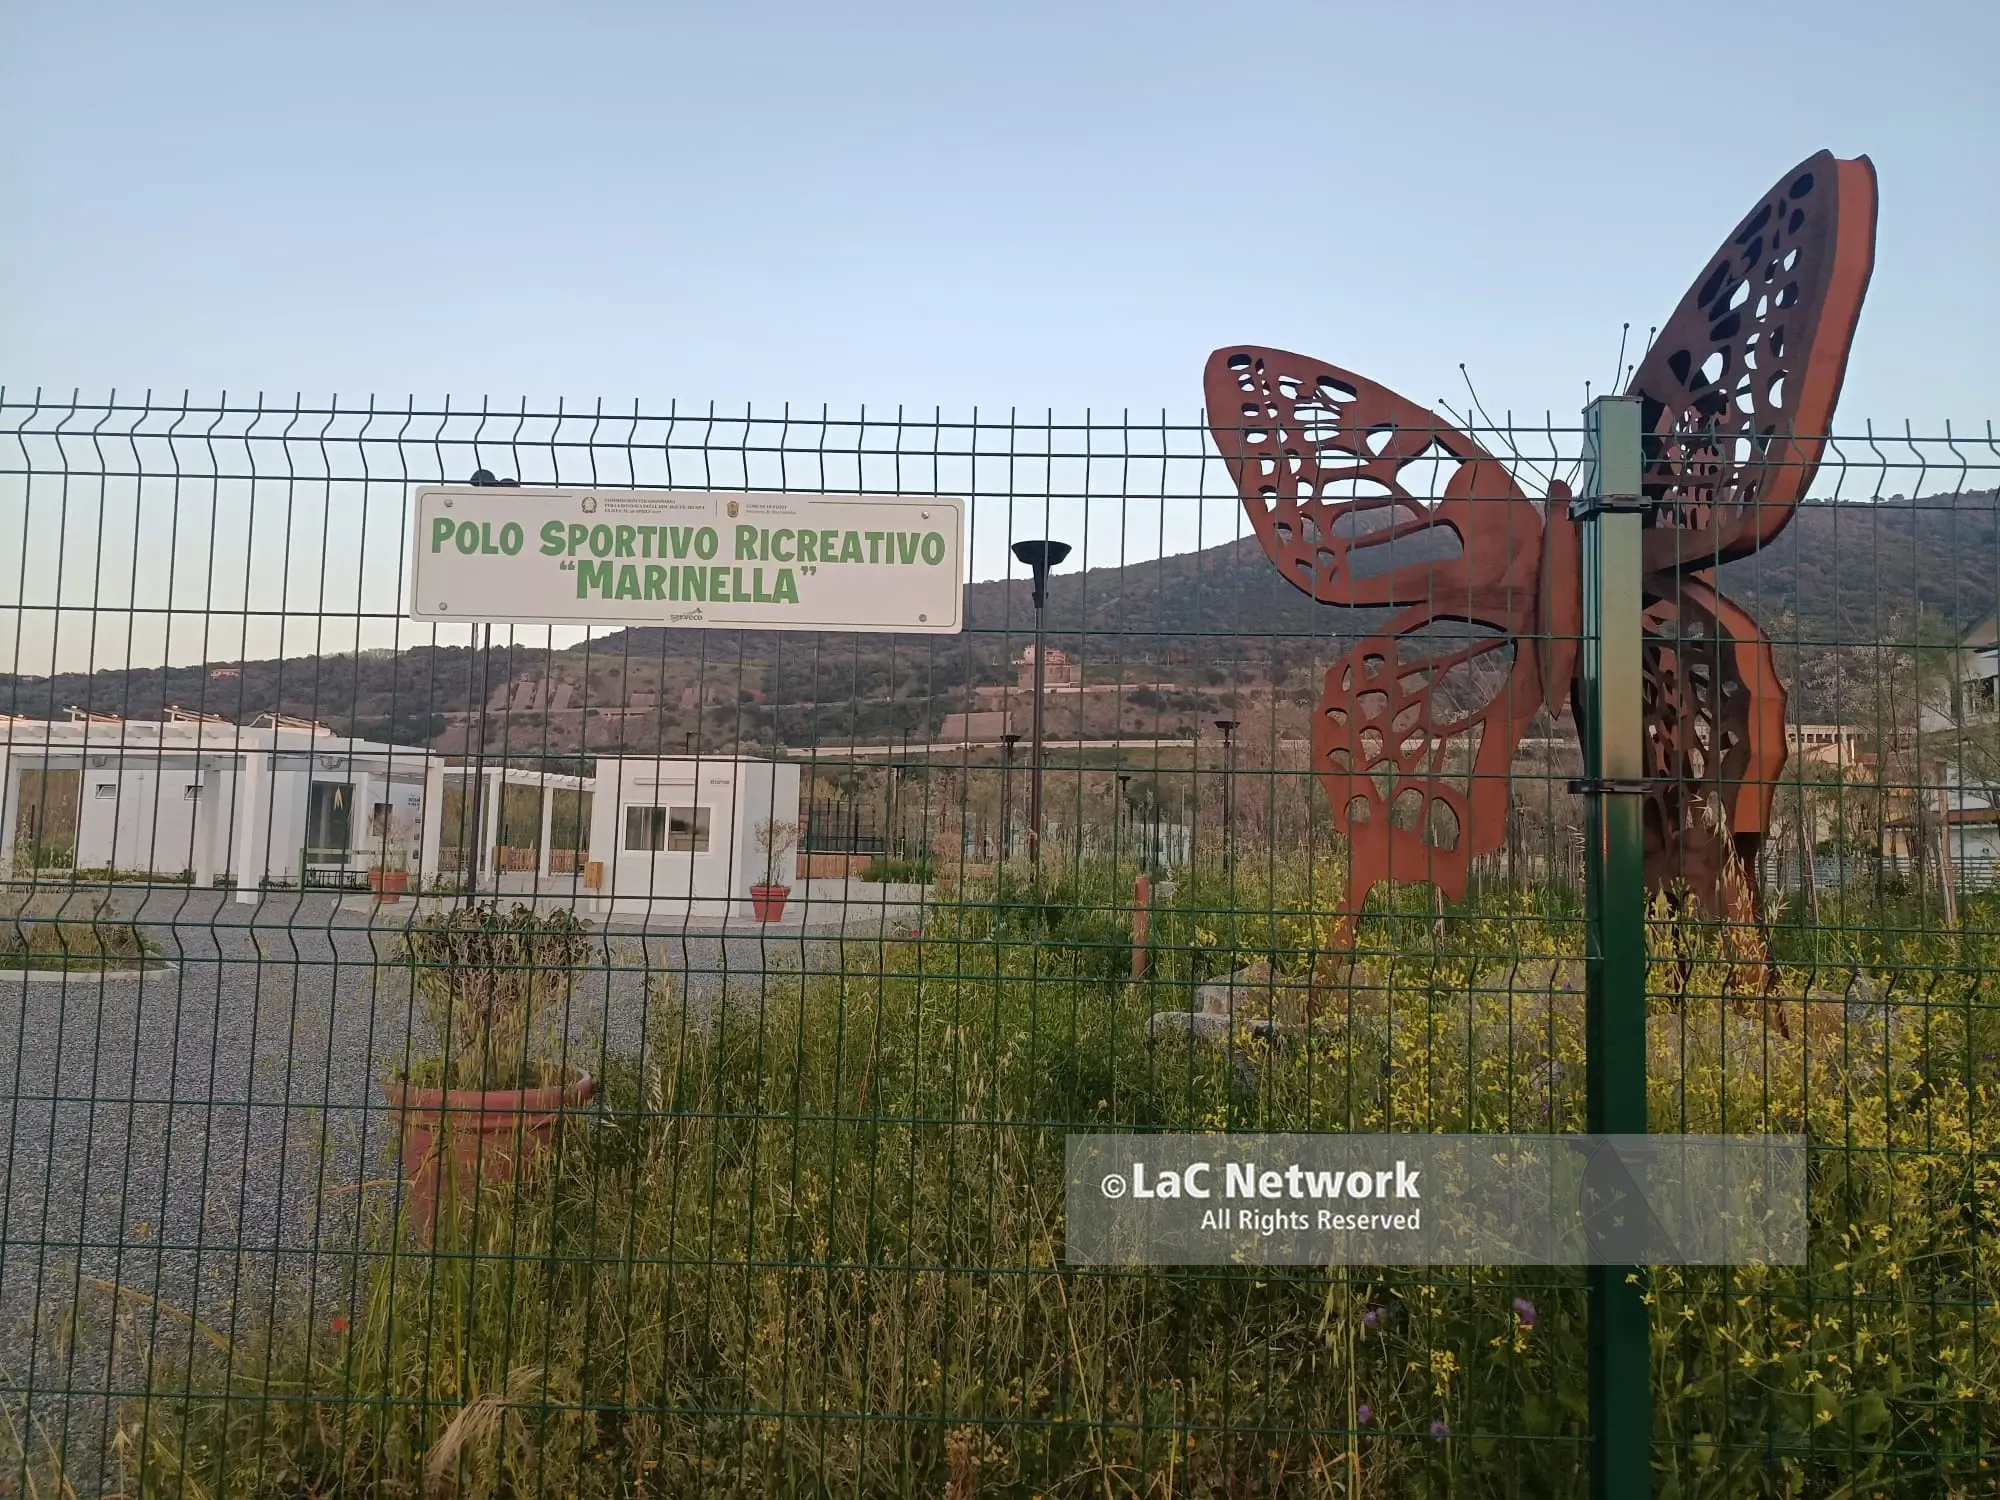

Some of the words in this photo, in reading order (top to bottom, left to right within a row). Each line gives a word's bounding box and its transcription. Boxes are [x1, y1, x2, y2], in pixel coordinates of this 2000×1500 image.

[431, 517, 524, 556] POLO
[539, 520, 719, 560] SPORTIVO
[735, 524, 946, 566] RICREATIVO
